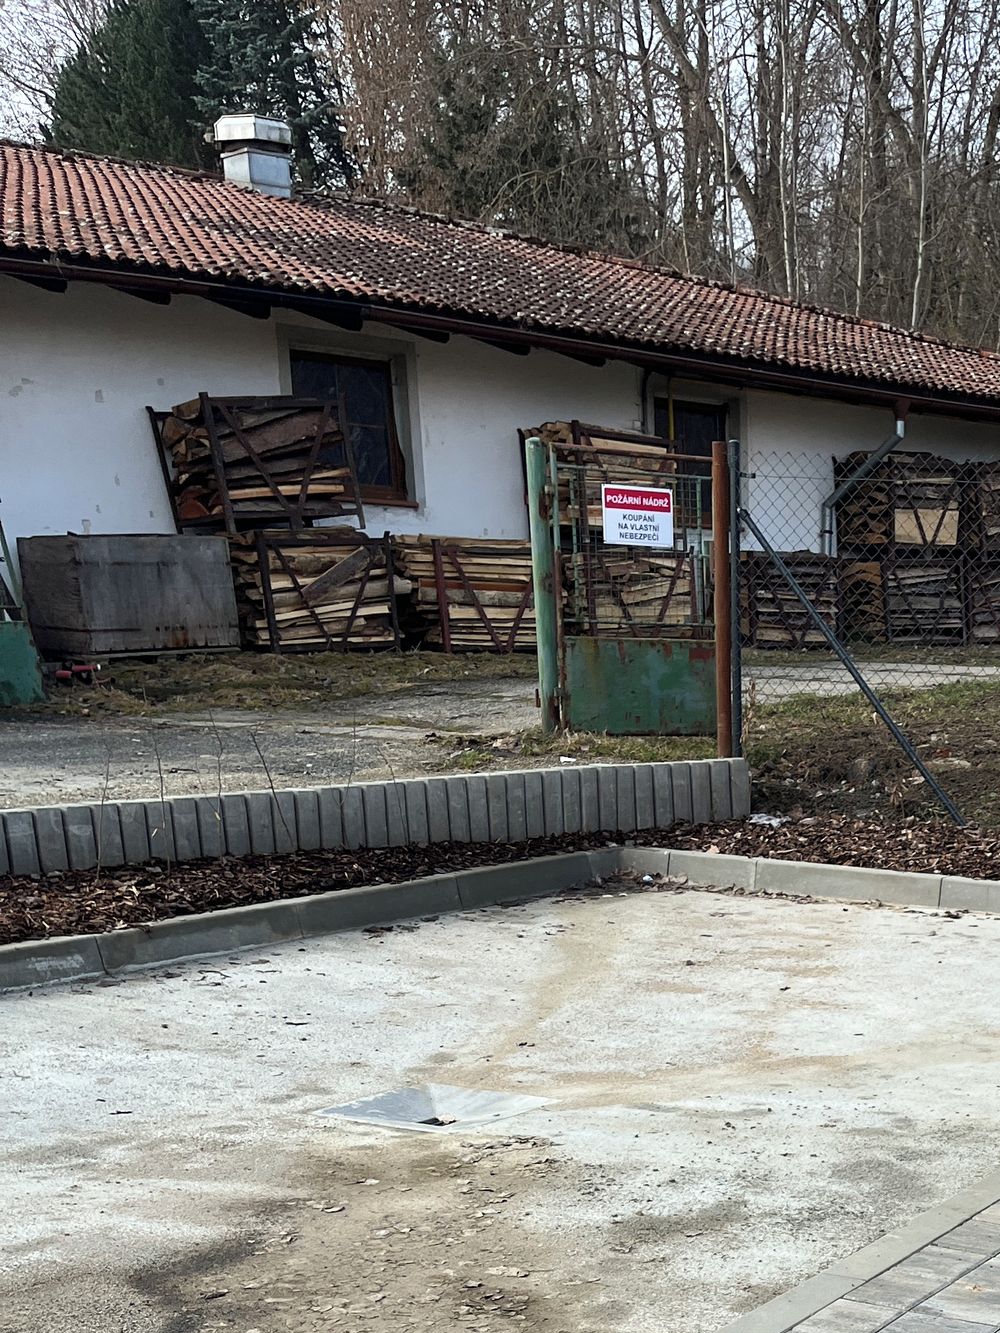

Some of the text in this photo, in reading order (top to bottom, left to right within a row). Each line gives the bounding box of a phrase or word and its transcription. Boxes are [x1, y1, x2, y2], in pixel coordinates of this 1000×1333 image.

[606, 494, 669, 508] POŽÁRNÍ NÁDRŽ
[618, 523, 660, 532] NA VLASTNÍ
[619, 532, 659, 541] NEBEZPEČÍ
